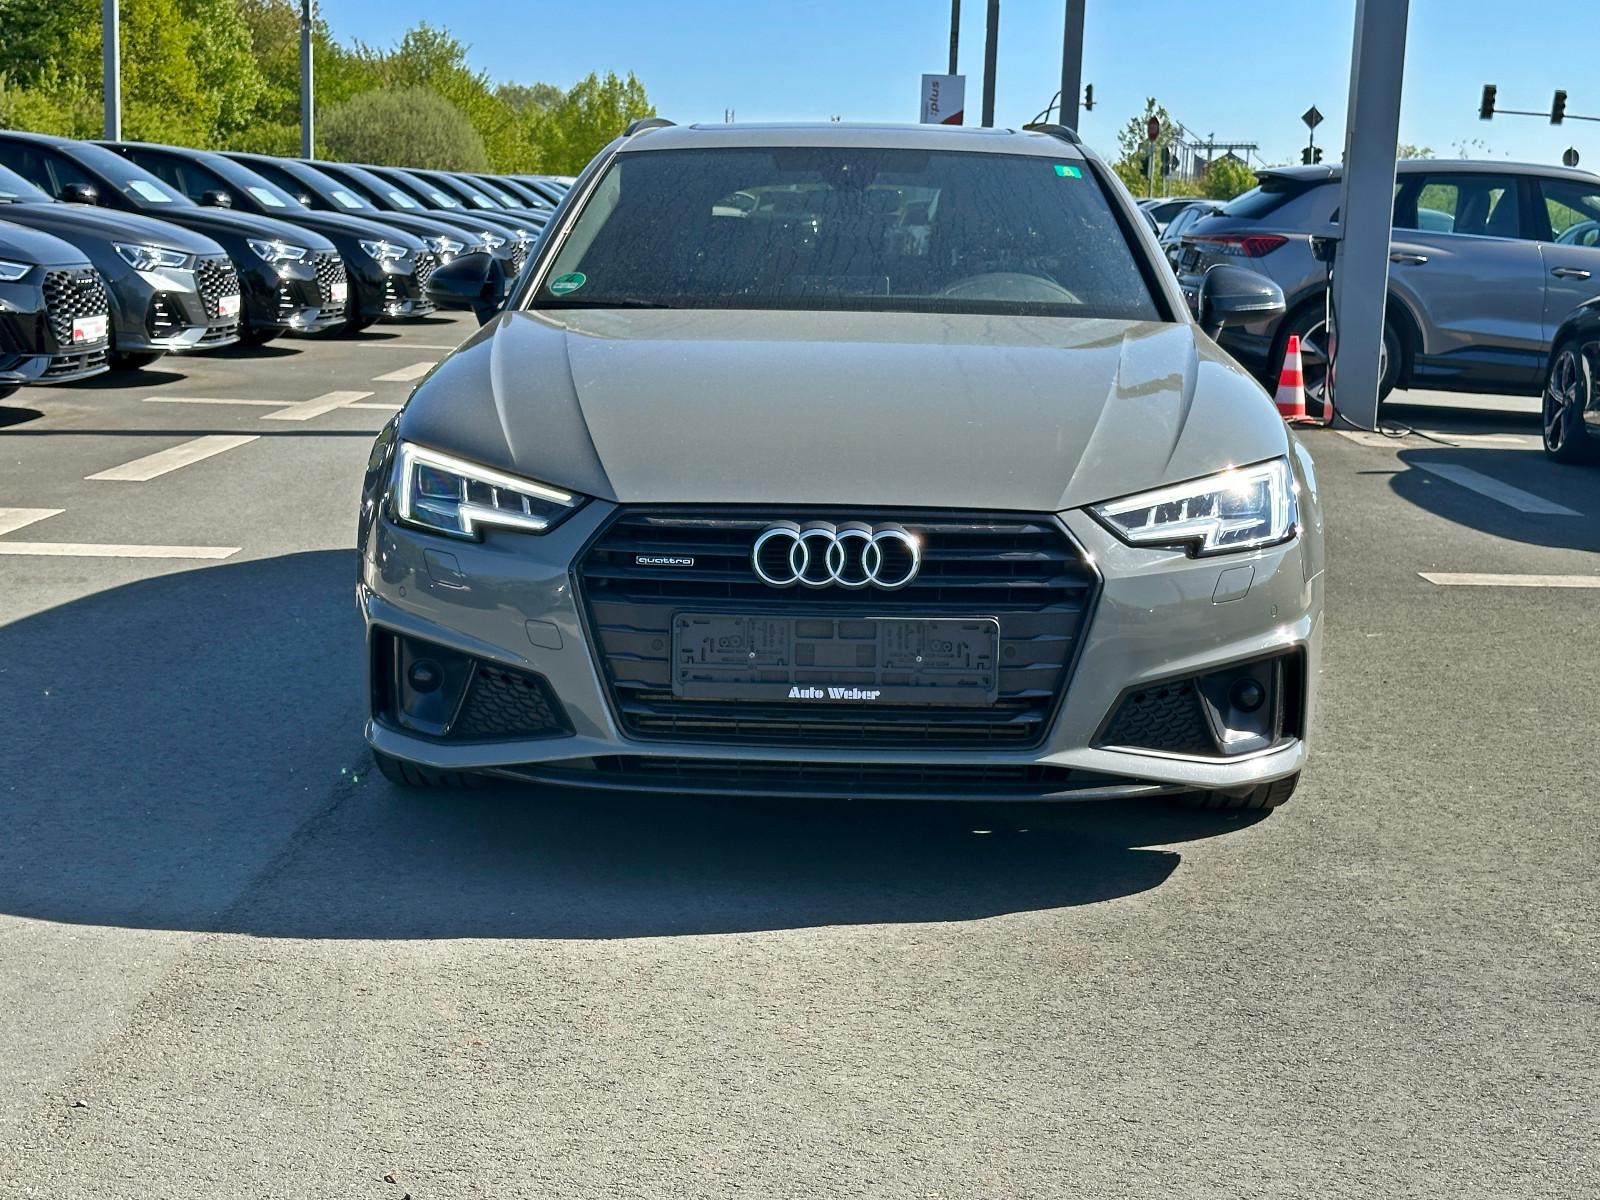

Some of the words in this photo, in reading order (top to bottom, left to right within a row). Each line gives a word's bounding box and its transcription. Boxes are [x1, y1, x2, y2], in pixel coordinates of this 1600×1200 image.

[637, 556, 692, 566] quattro
[788, 686, 824, 699] Auto
[827, 687, 881, 700] Weber
